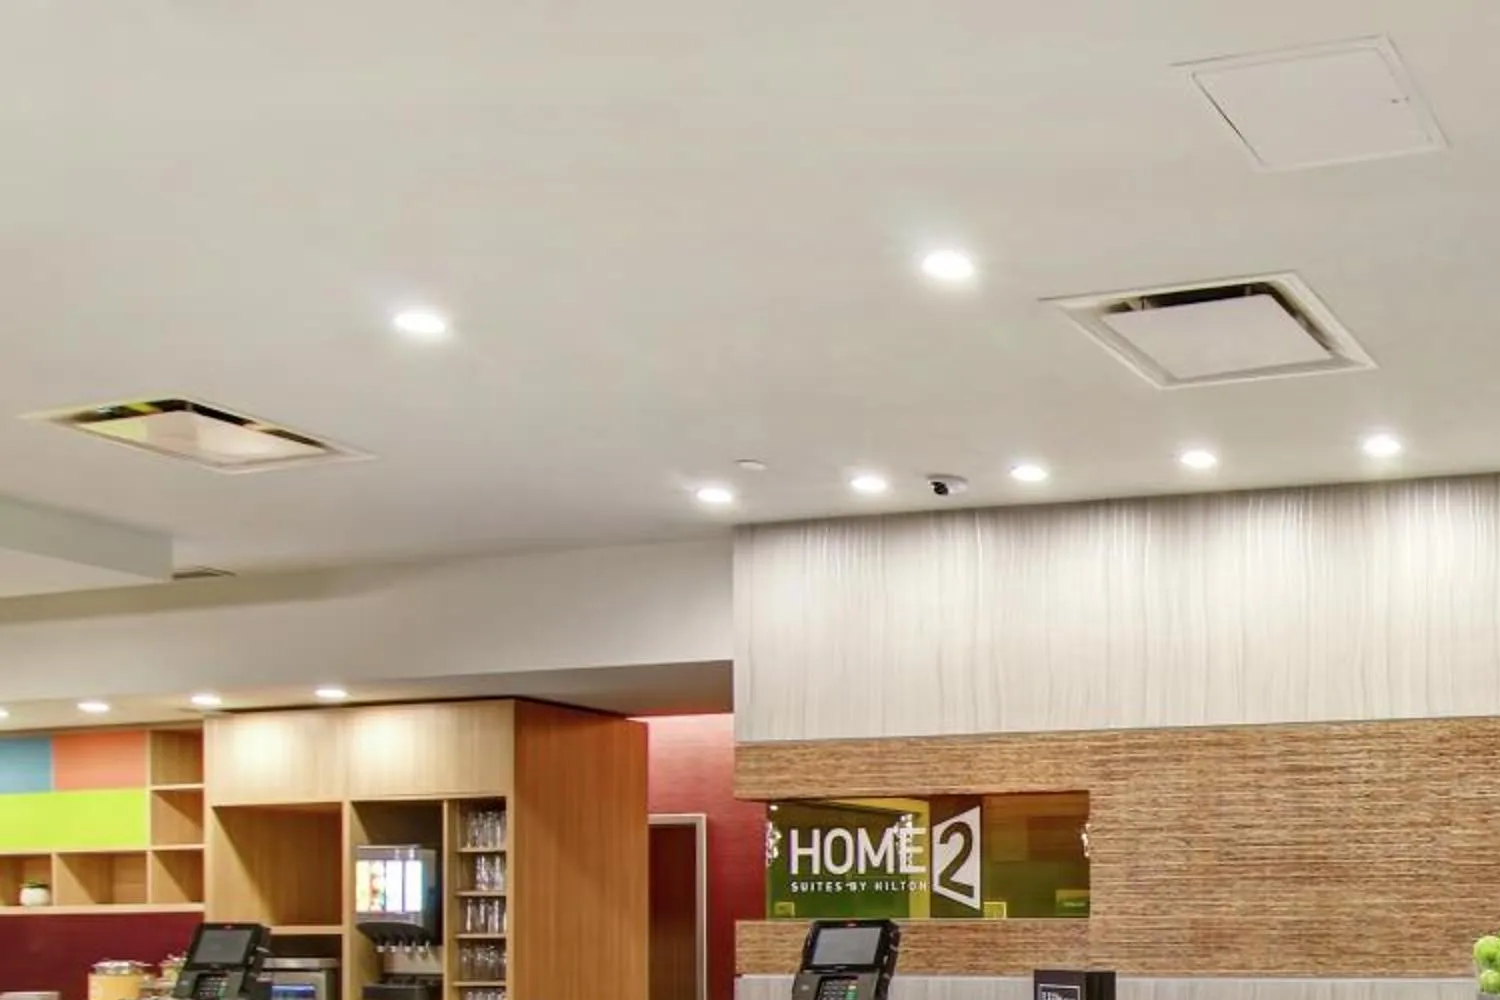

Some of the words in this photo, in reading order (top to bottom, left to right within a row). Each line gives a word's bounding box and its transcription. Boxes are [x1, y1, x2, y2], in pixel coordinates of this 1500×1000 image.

[791, 881, 843, 893] SUITES
[849, 881, 867, 892] BY
[874, 881, 928, 892] HILTON
